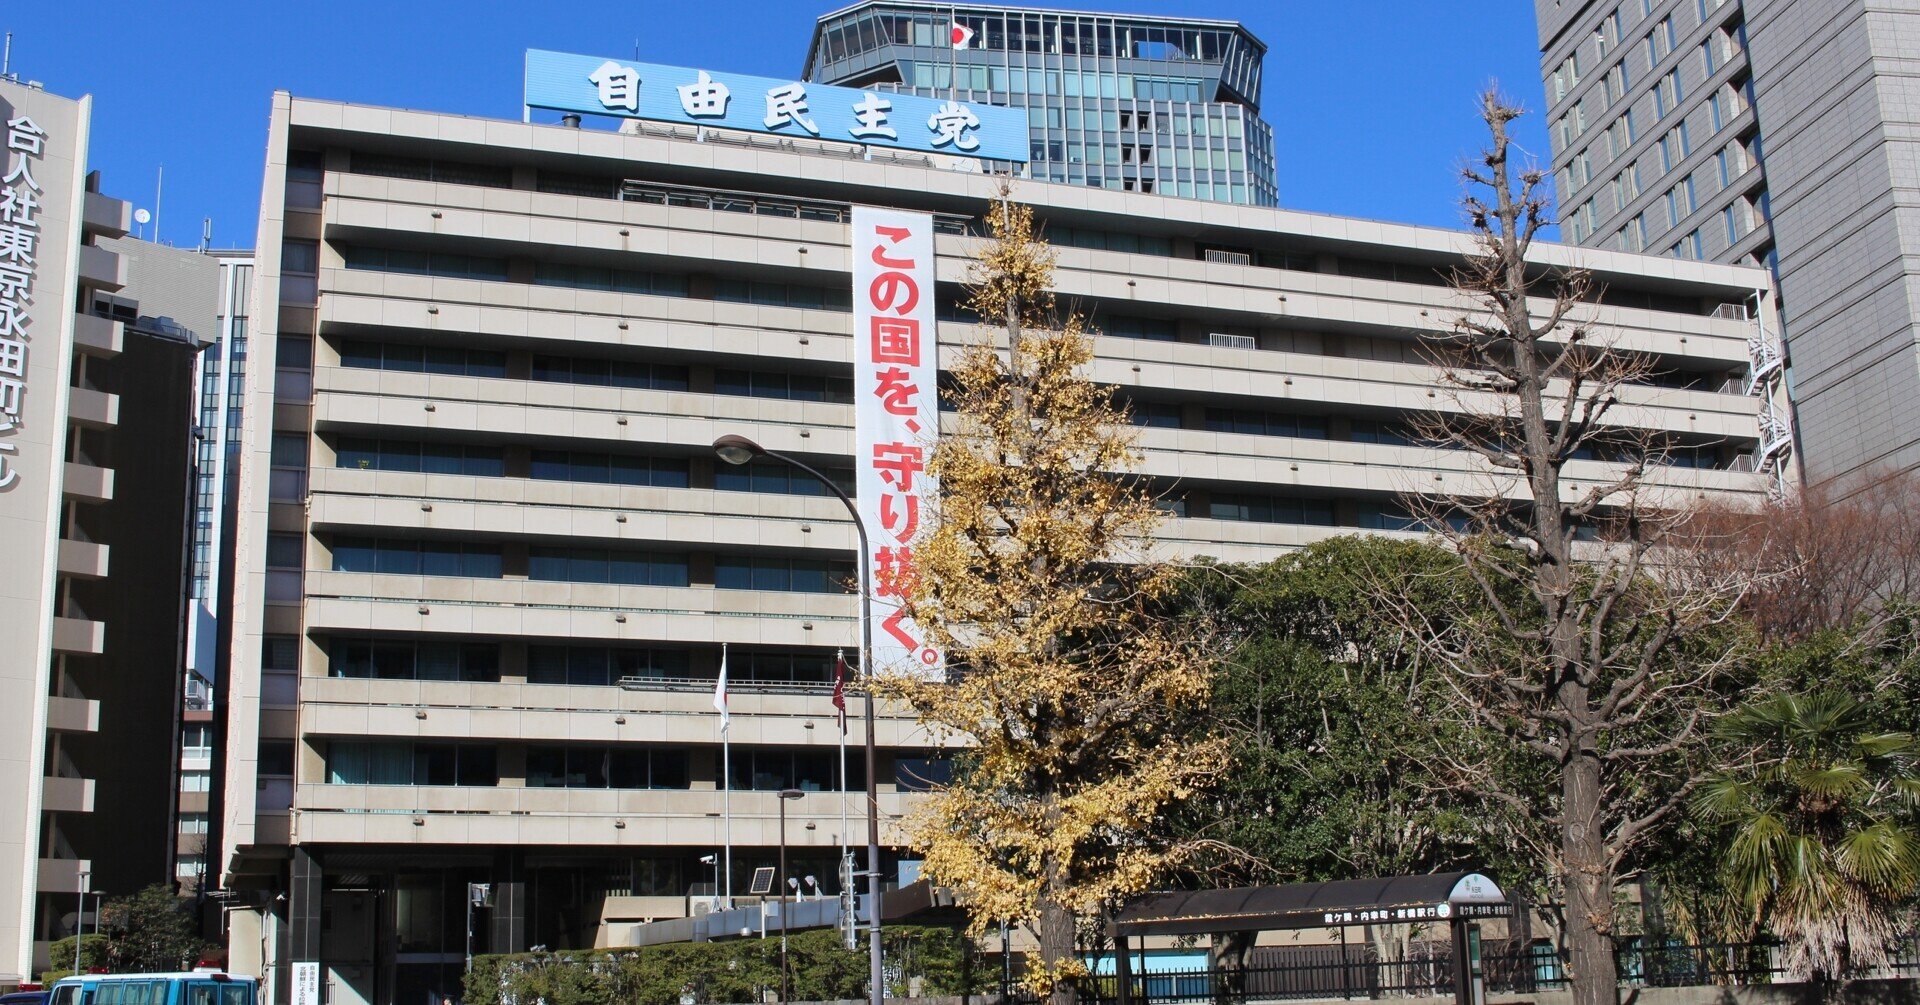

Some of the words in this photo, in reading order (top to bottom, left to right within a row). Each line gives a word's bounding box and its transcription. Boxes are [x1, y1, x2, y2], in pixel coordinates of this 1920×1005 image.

[588, 61, 980, 152] 自由民主党
